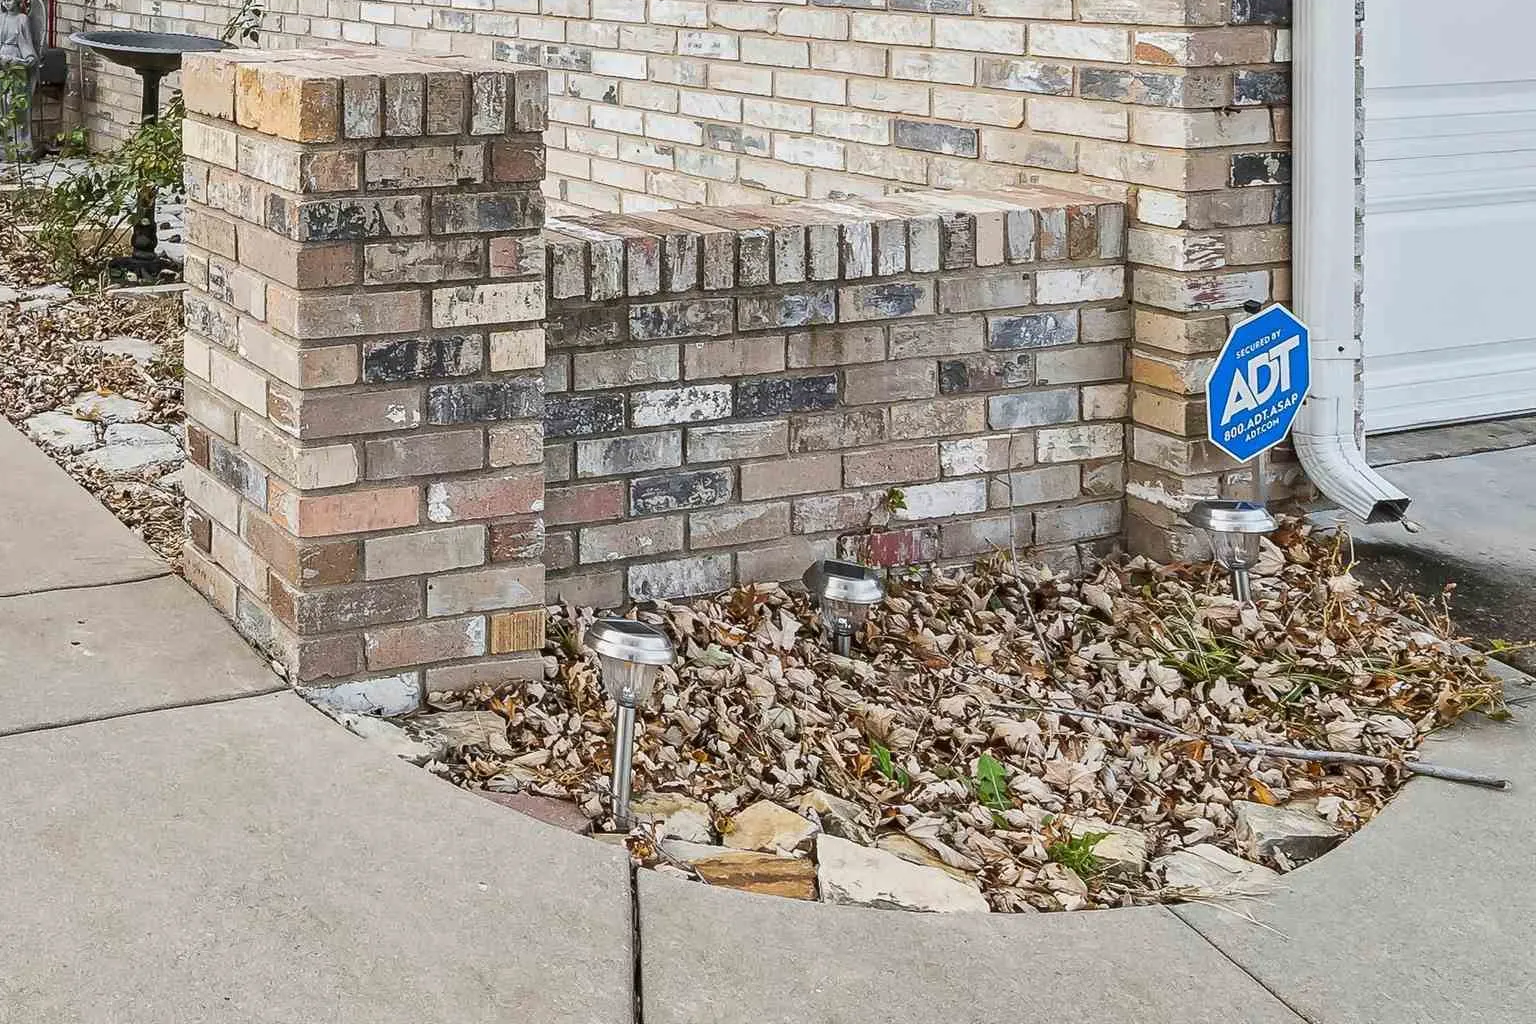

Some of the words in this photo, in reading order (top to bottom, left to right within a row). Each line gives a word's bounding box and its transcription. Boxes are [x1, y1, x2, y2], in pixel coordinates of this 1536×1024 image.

[1236, 336, 1271, 359] SECURED
[1271, 329, 1282, 341] BY
[1221, 335, 1300, 426] ADT
[1223, 393, 1299, 442] 800.ADT.ASAP
[1245, 418, 1280, 442] ADT.COM
